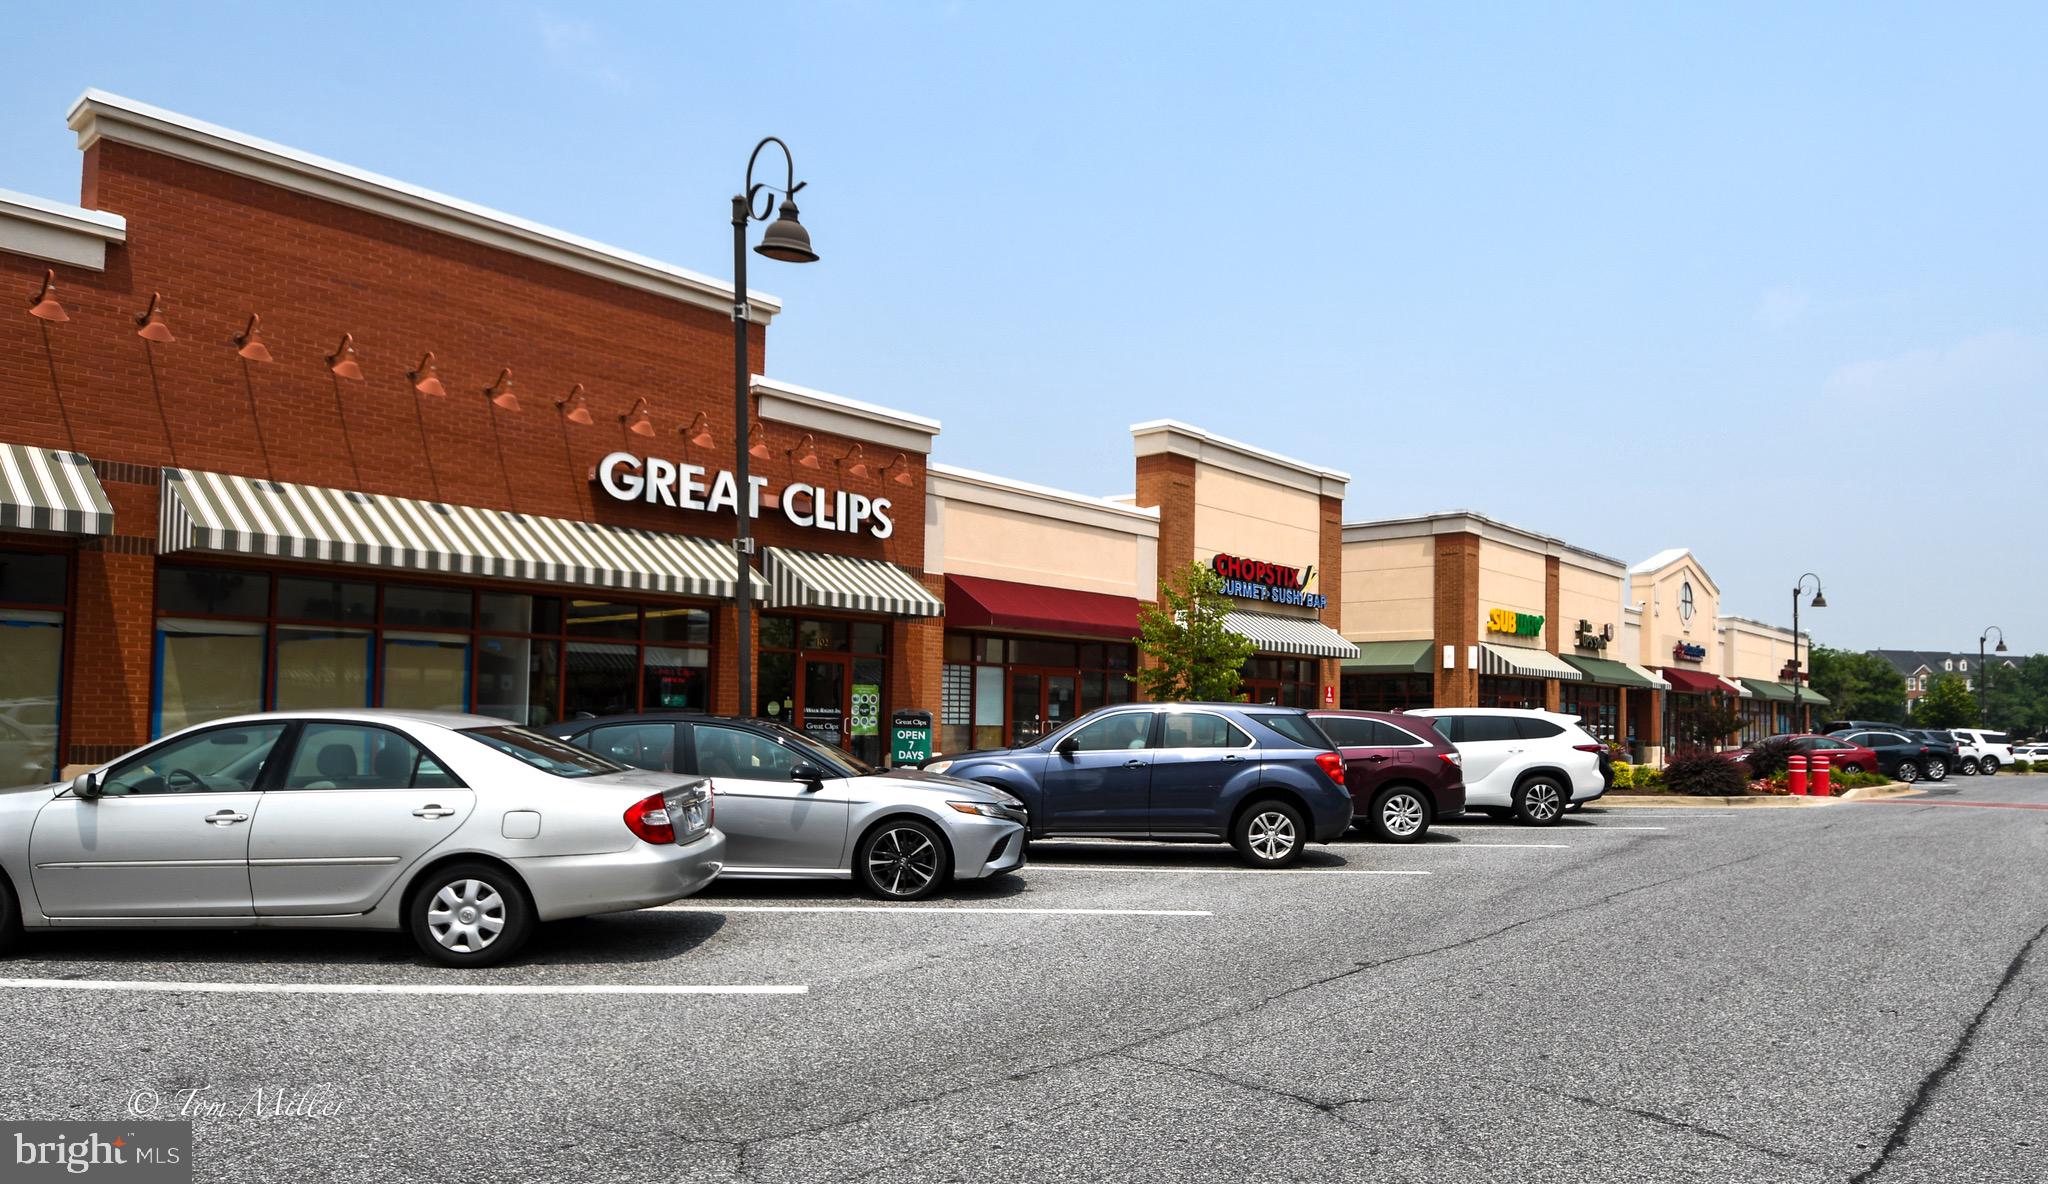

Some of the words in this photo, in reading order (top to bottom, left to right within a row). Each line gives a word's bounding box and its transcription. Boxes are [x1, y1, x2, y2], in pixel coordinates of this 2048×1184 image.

[599, 451, 768, 518] GREAT
[782, 482, 894, 539] CLIPS
[1214, 553, 1301, 589] CHOPSTIX
[1271, 586, 1304, 606] SUSHI
[1306, 593, 1328, 609] BAR
[1487, 608, 1545, 637] SUBWAY
[806, 723, 824, 731] Great
[824, 723, 839, 732] Clips
[912, 719, 927, 727] Clips
[897, 730, 926, 740] OPEN
[908, 740, 915, 750] 7
[898, 750, 924, 760] DAYS
